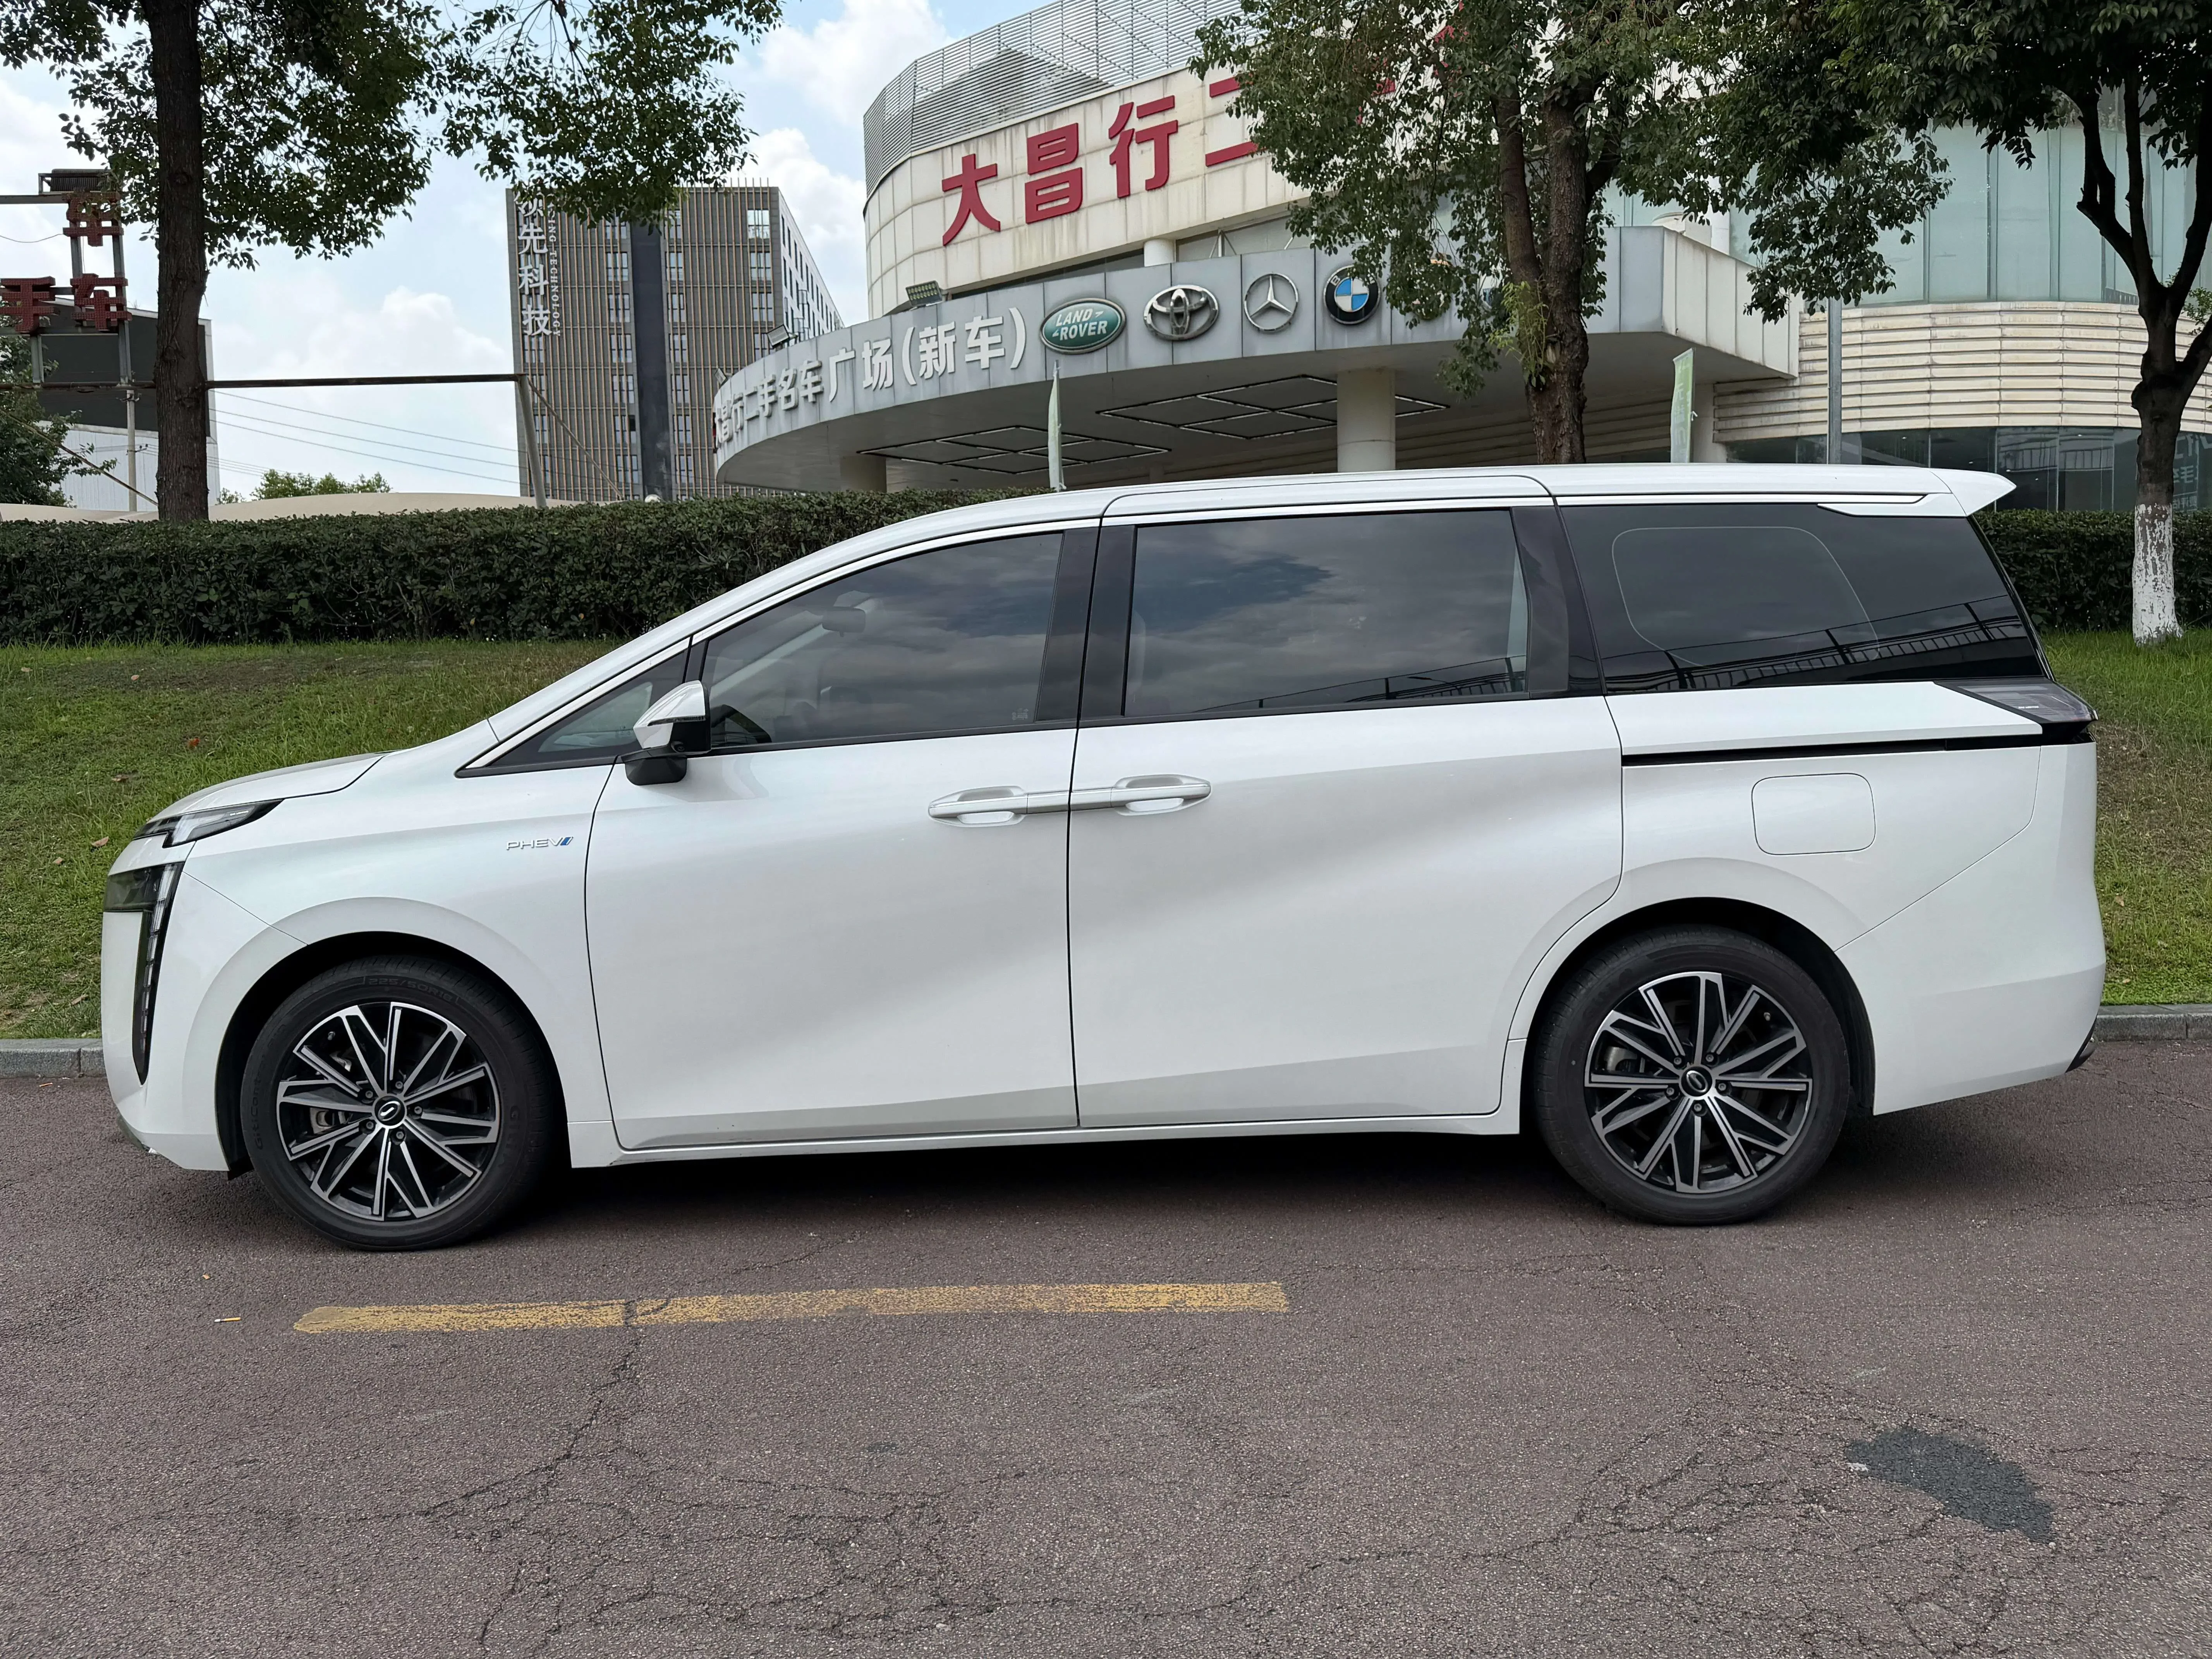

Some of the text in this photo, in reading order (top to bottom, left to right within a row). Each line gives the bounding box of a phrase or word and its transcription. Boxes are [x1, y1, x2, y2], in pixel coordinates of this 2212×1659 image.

[550, 250, 561, 337] TECHNOLOGY
[1056, 308, 1093, 327] LAND
[1060, 321, 1108, 341] ROVER
[507, 837, 563, 851] PHEV
